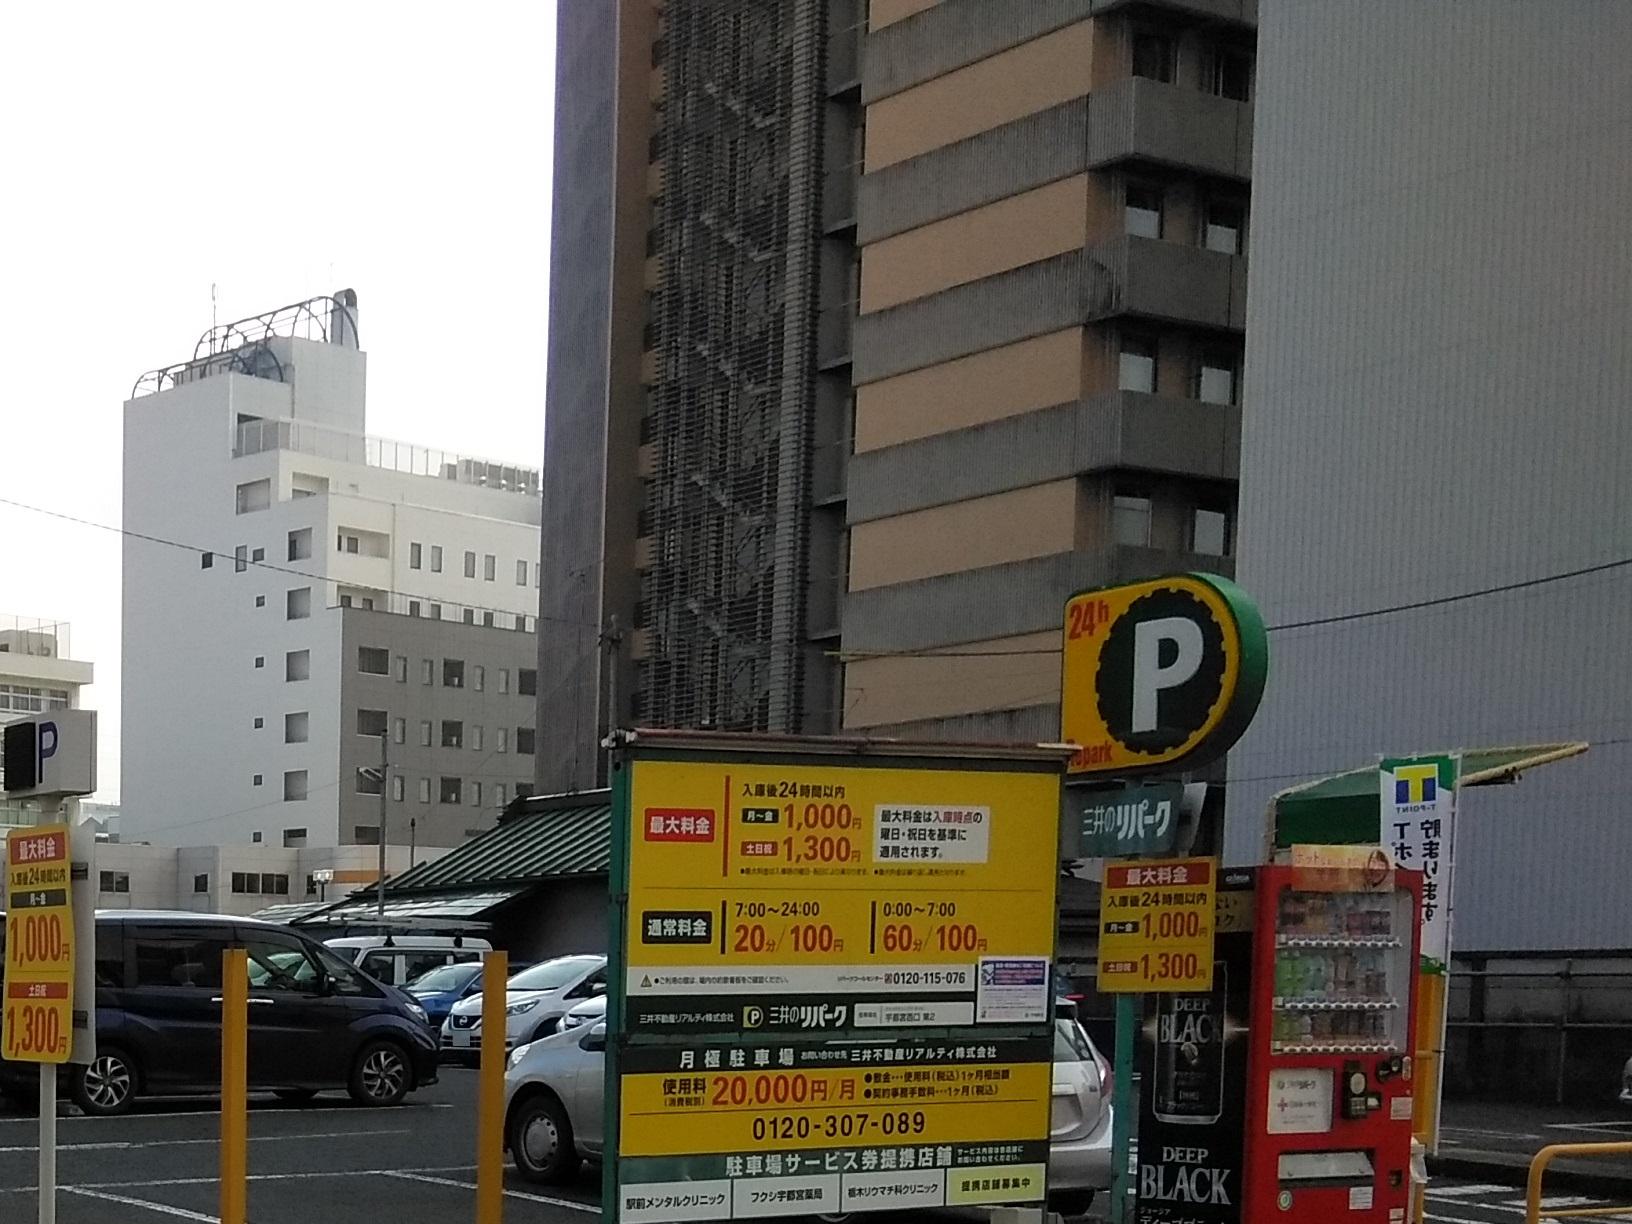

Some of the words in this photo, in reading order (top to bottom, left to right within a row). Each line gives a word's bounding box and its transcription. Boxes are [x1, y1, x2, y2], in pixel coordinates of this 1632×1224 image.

[1068, 600, 1109, 640] 24h
[1132, 616, 1204, 733] P
[38, 721, 58, 784] P
[742, 781, 845, 798] 入庫後24時間以内
[650, 817, 710, 835] 最大料金
[784, 803, 862, 831] 1,000円
[881, 810, 983, 824] 最大料金は入庫時点の
[1082, 800, 1171, 841] 三井のリパーク
[19, 838, 56, 861] 最大料金
[746, 844, 773, 854] 土日祝
[783, 835, 861, 863] 1,300円
[879, 846, 943, 859] 適用されます。
[10, 867, 66, 887] 入庫後24時間以内
[1126, 866, 1189, 885] 最大料金
[1107, 891, 1208, 908] 入庫後24時間以内
[648, 919, 707, 936] 通常料金
[1142, 912, 1207, 941] 1,000円
[10, 915, 69, 967] 1,000円
[893, 972, 966, 986] 0120-115-076
[1140, 954, 1207, 982] 1,300円
[639, 1013, 734, 1024] 三井不動産リアルティ株式会社
[769, 1004, 847, 1028] 三井のリパーク
[7, 1006, 66, 1057] 1,300円
[680, 1048, 794, 1069] 月極駐車場
[850, 1046, 997, 1062] 三井不動産リアルティ株式会社
[663, 1078, 706, 1095] 使用料
[752, 1111, 925, 1140] 0120-307-089
[725, 1145, 952, 1177] 駐車場サービス券提携店舗
[1162, 1146, 1209, 1164] DEEP
[751, 1188, 823, 1203] フクシ宇都宮薬局
[848, 1183, 938, 1199] 栃木リウマチ科クリニック
[961, 1177, 1031, 1192] 提携店舗募集中
[1140, 1164, 1232, 1205] BLACK
[626, 1193, 726, 1210] 駅前メンタルクリニック
